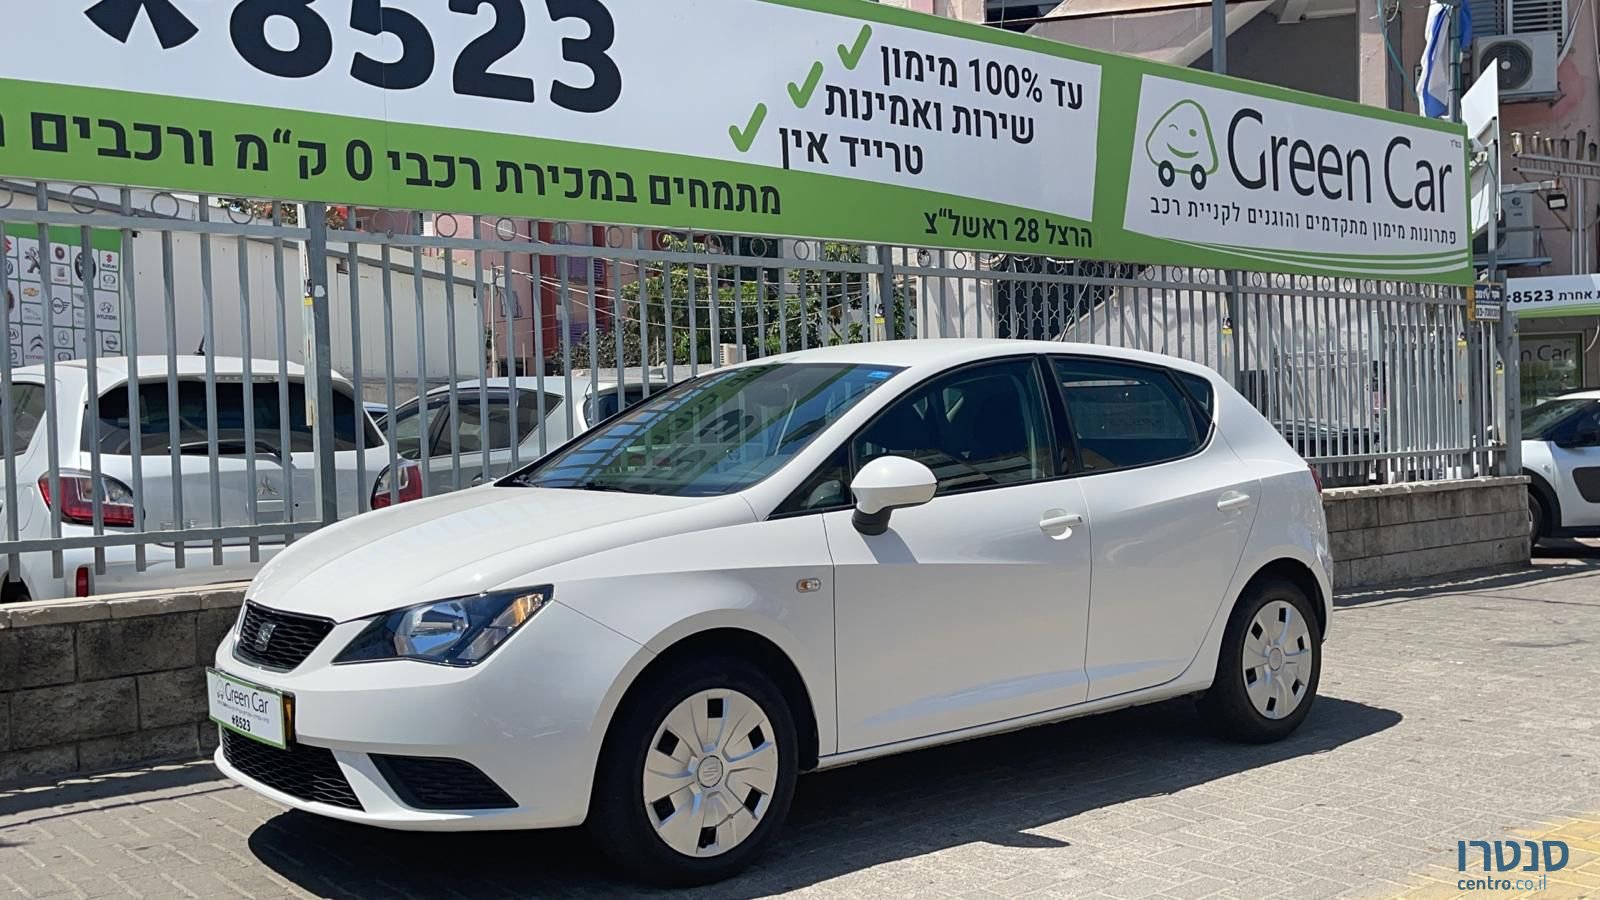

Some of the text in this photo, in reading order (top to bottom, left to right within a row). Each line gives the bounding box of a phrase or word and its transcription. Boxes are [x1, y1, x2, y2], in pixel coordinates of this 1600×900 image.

[880, 45, 1084, 110] עד 100% מימון
[824, 84, 1035, 144] שירות ואמינות
[30, 111, 214, 167] ורכבים
[345, 139, 373, 181] 0
[778, 127, 924, 175] טרייד אין
[1227, 108, 1453, 213] Green Car
[387, 150, 482, 191] רכבי
[495, 159, 638, 203] במכירת
[649, 174, 782, 216] מתמחים
[924, 207, 1093, 249] הרצל 28 ראשל"צ
[1150, 196, 1456, 245] פתרונות מימון מתקדמים והוגנים לקניית רכב
[1558, 290, 1593, 302] אחרת
[1537, 344, 1572, 362] Car
[224, 683, 250, 707] Green
[251, 692, 269, 715] Car
